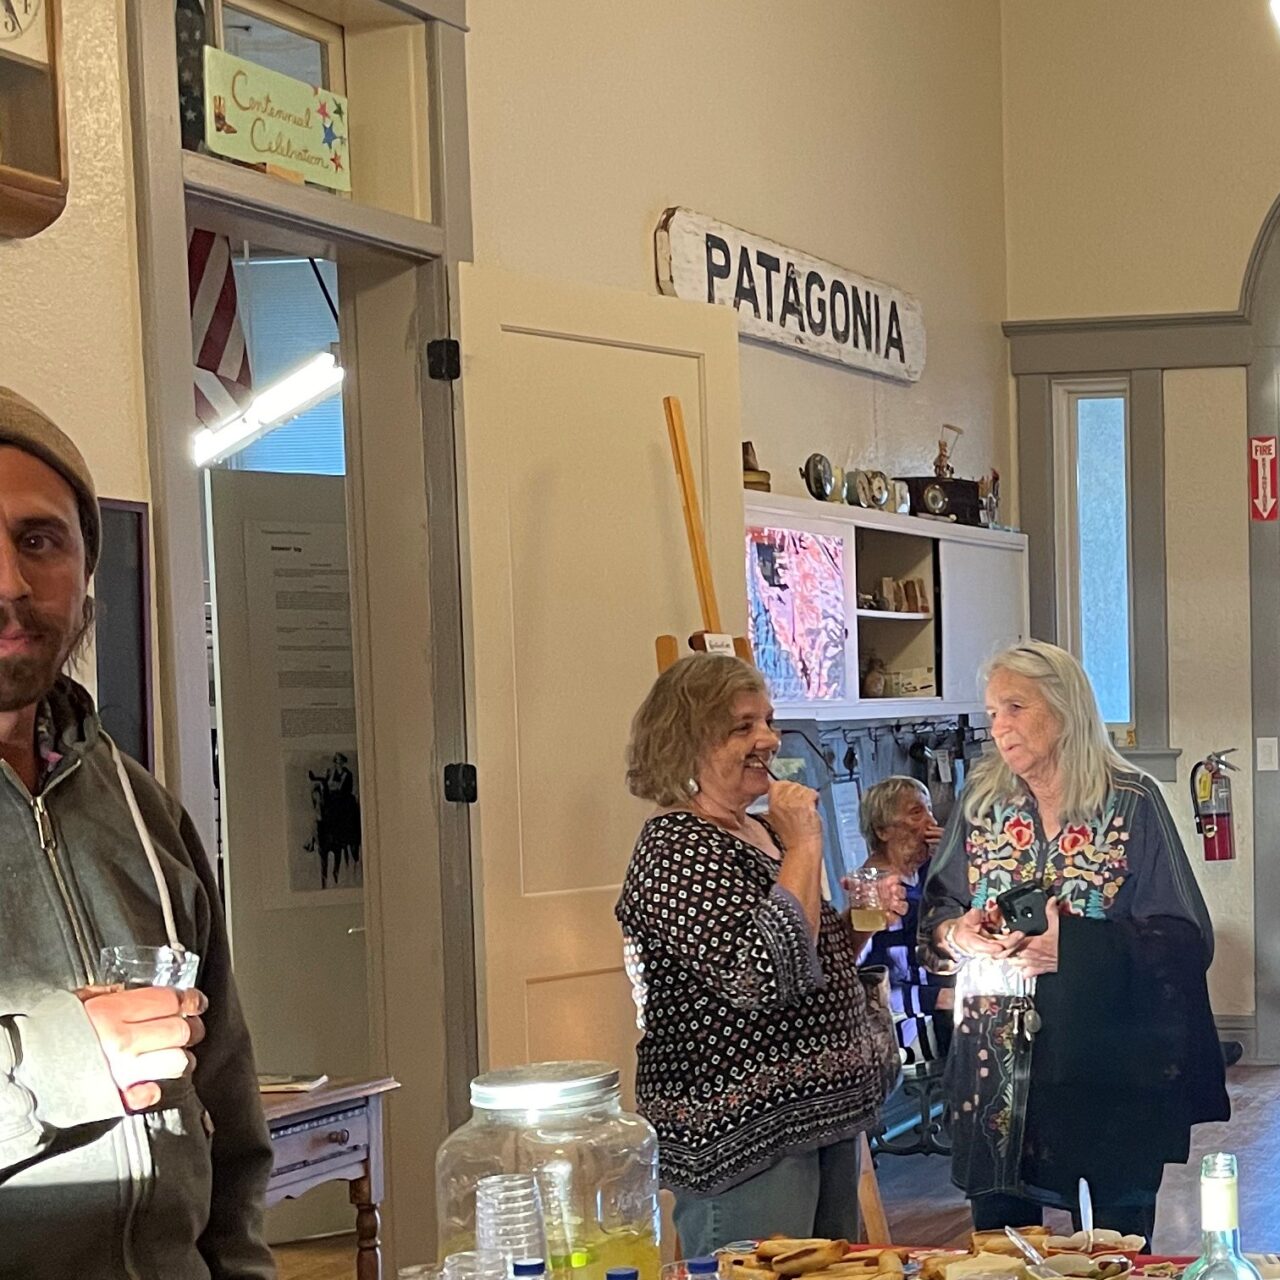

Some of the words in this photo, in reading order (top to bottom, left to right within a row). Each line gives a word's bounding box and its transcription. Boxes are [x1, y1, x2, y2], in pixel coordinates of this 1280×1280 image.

[231, 70, 313, 129] Centennial
[250, 117, 329, 169] Celebration
[705, 232, 905, 364] PATAGONIA
[1254, 444, 1273, 456] FIRE
